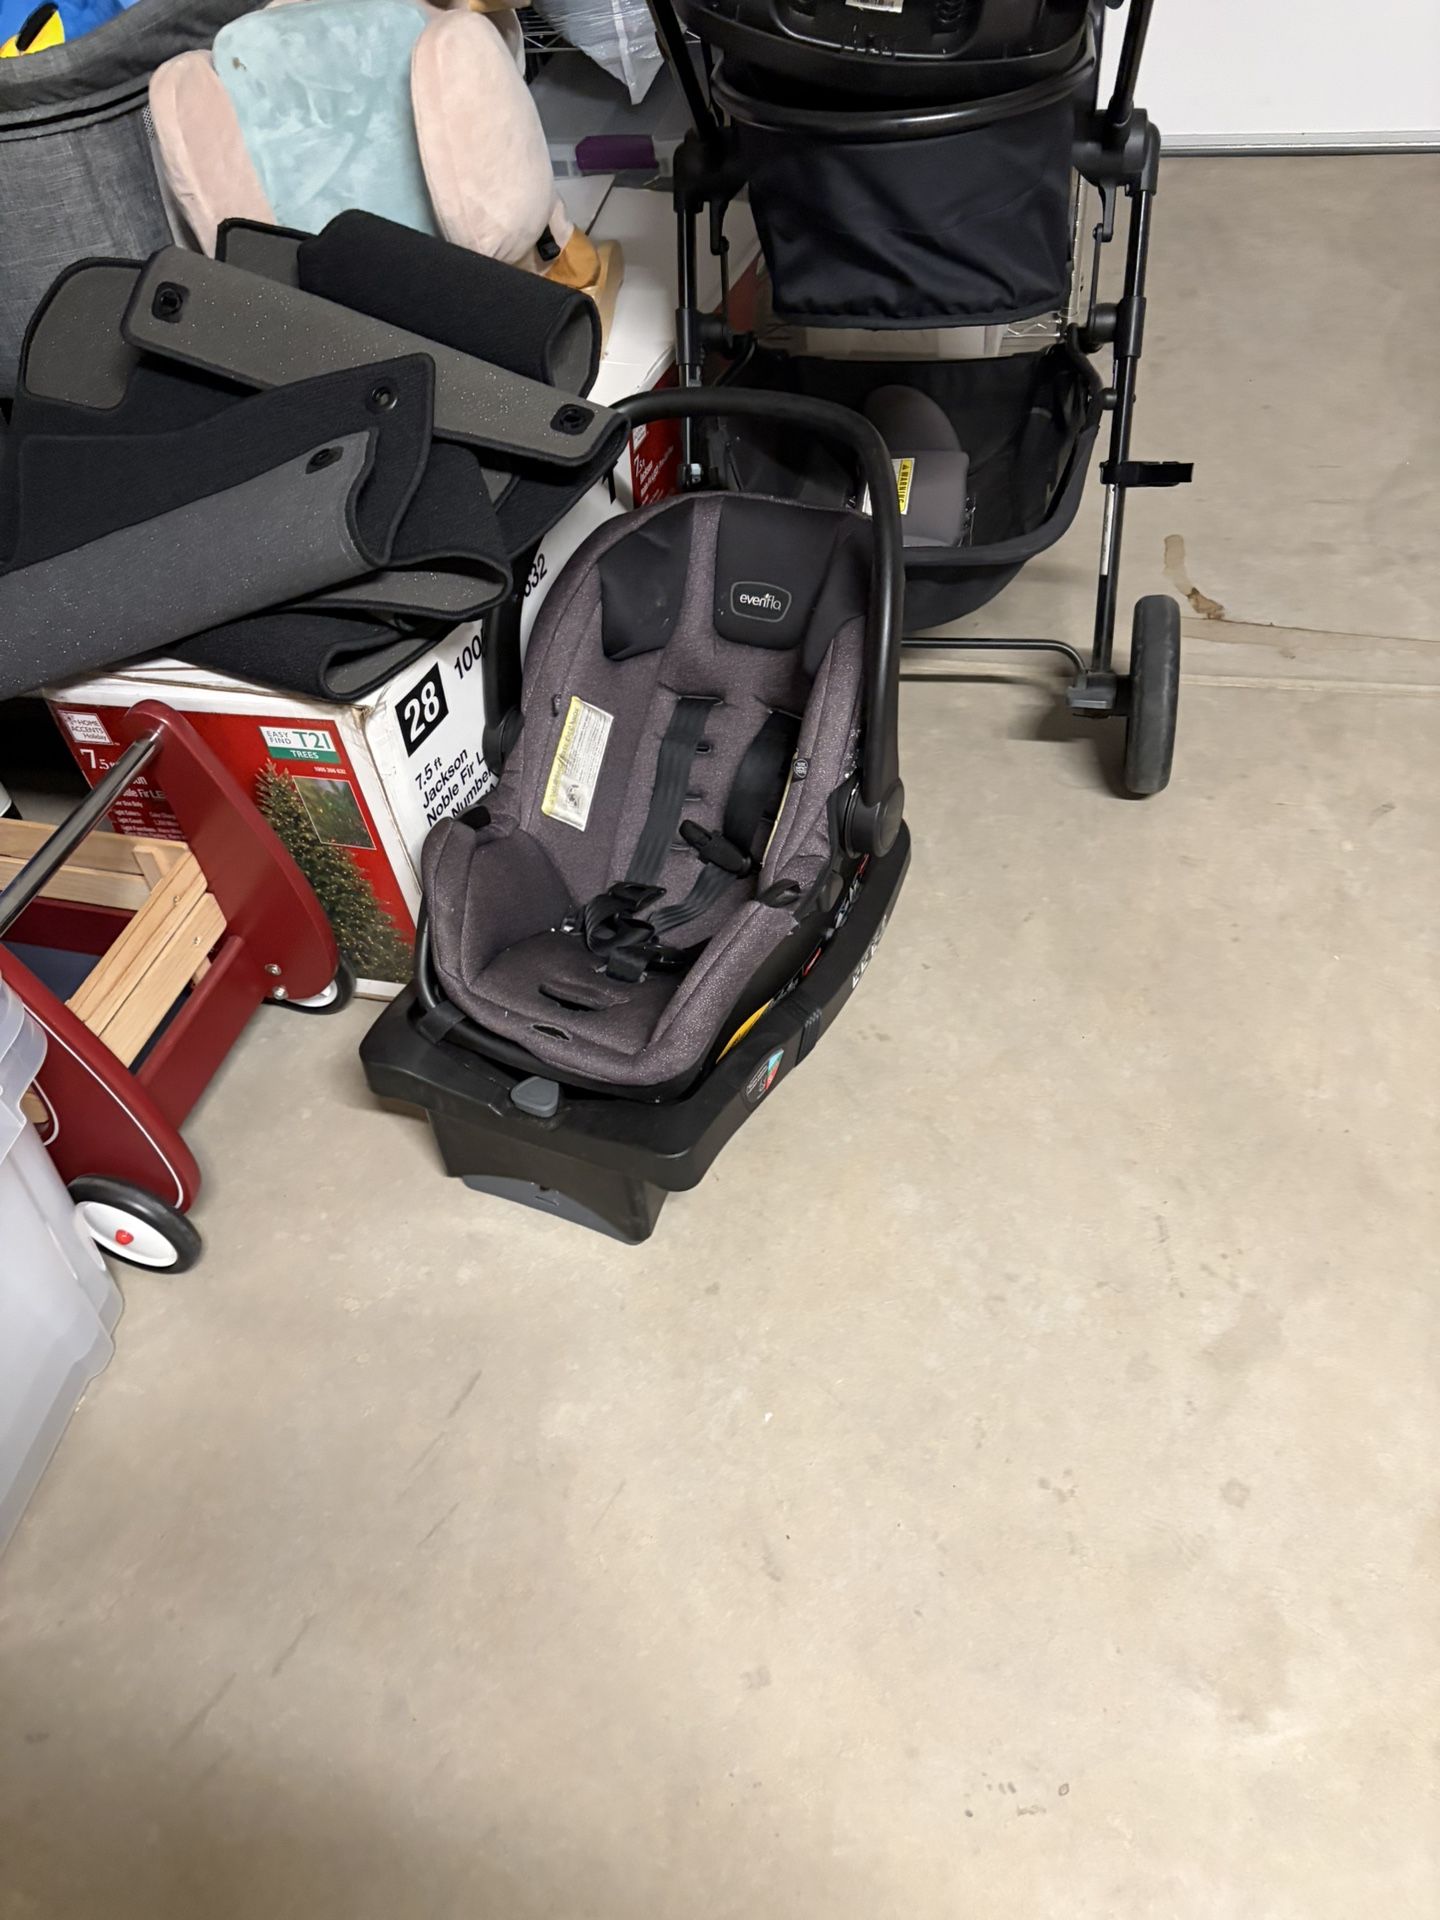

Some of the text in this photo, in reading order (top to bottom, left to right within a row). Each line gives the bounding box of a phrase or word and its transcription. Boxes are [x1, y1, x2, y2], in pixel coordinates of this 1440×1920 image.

[739, 593, 782, 611] evenflo
[454, 628, 484, 680] 100
[404, 681, 440, 743] 28
[71, 726, 104, 734] ACCENTS
[83, 733, 107, 741] Holiday
[269, 737, 292, 745] FIND
[290, 750, 319, 759] TREES
[415, 757, 443, 790] 7.5 ft
[422, 749, 468, 809] Jackson
[426, 782, 459, 827] Noble
[460, 761, 475, 786] Fir
